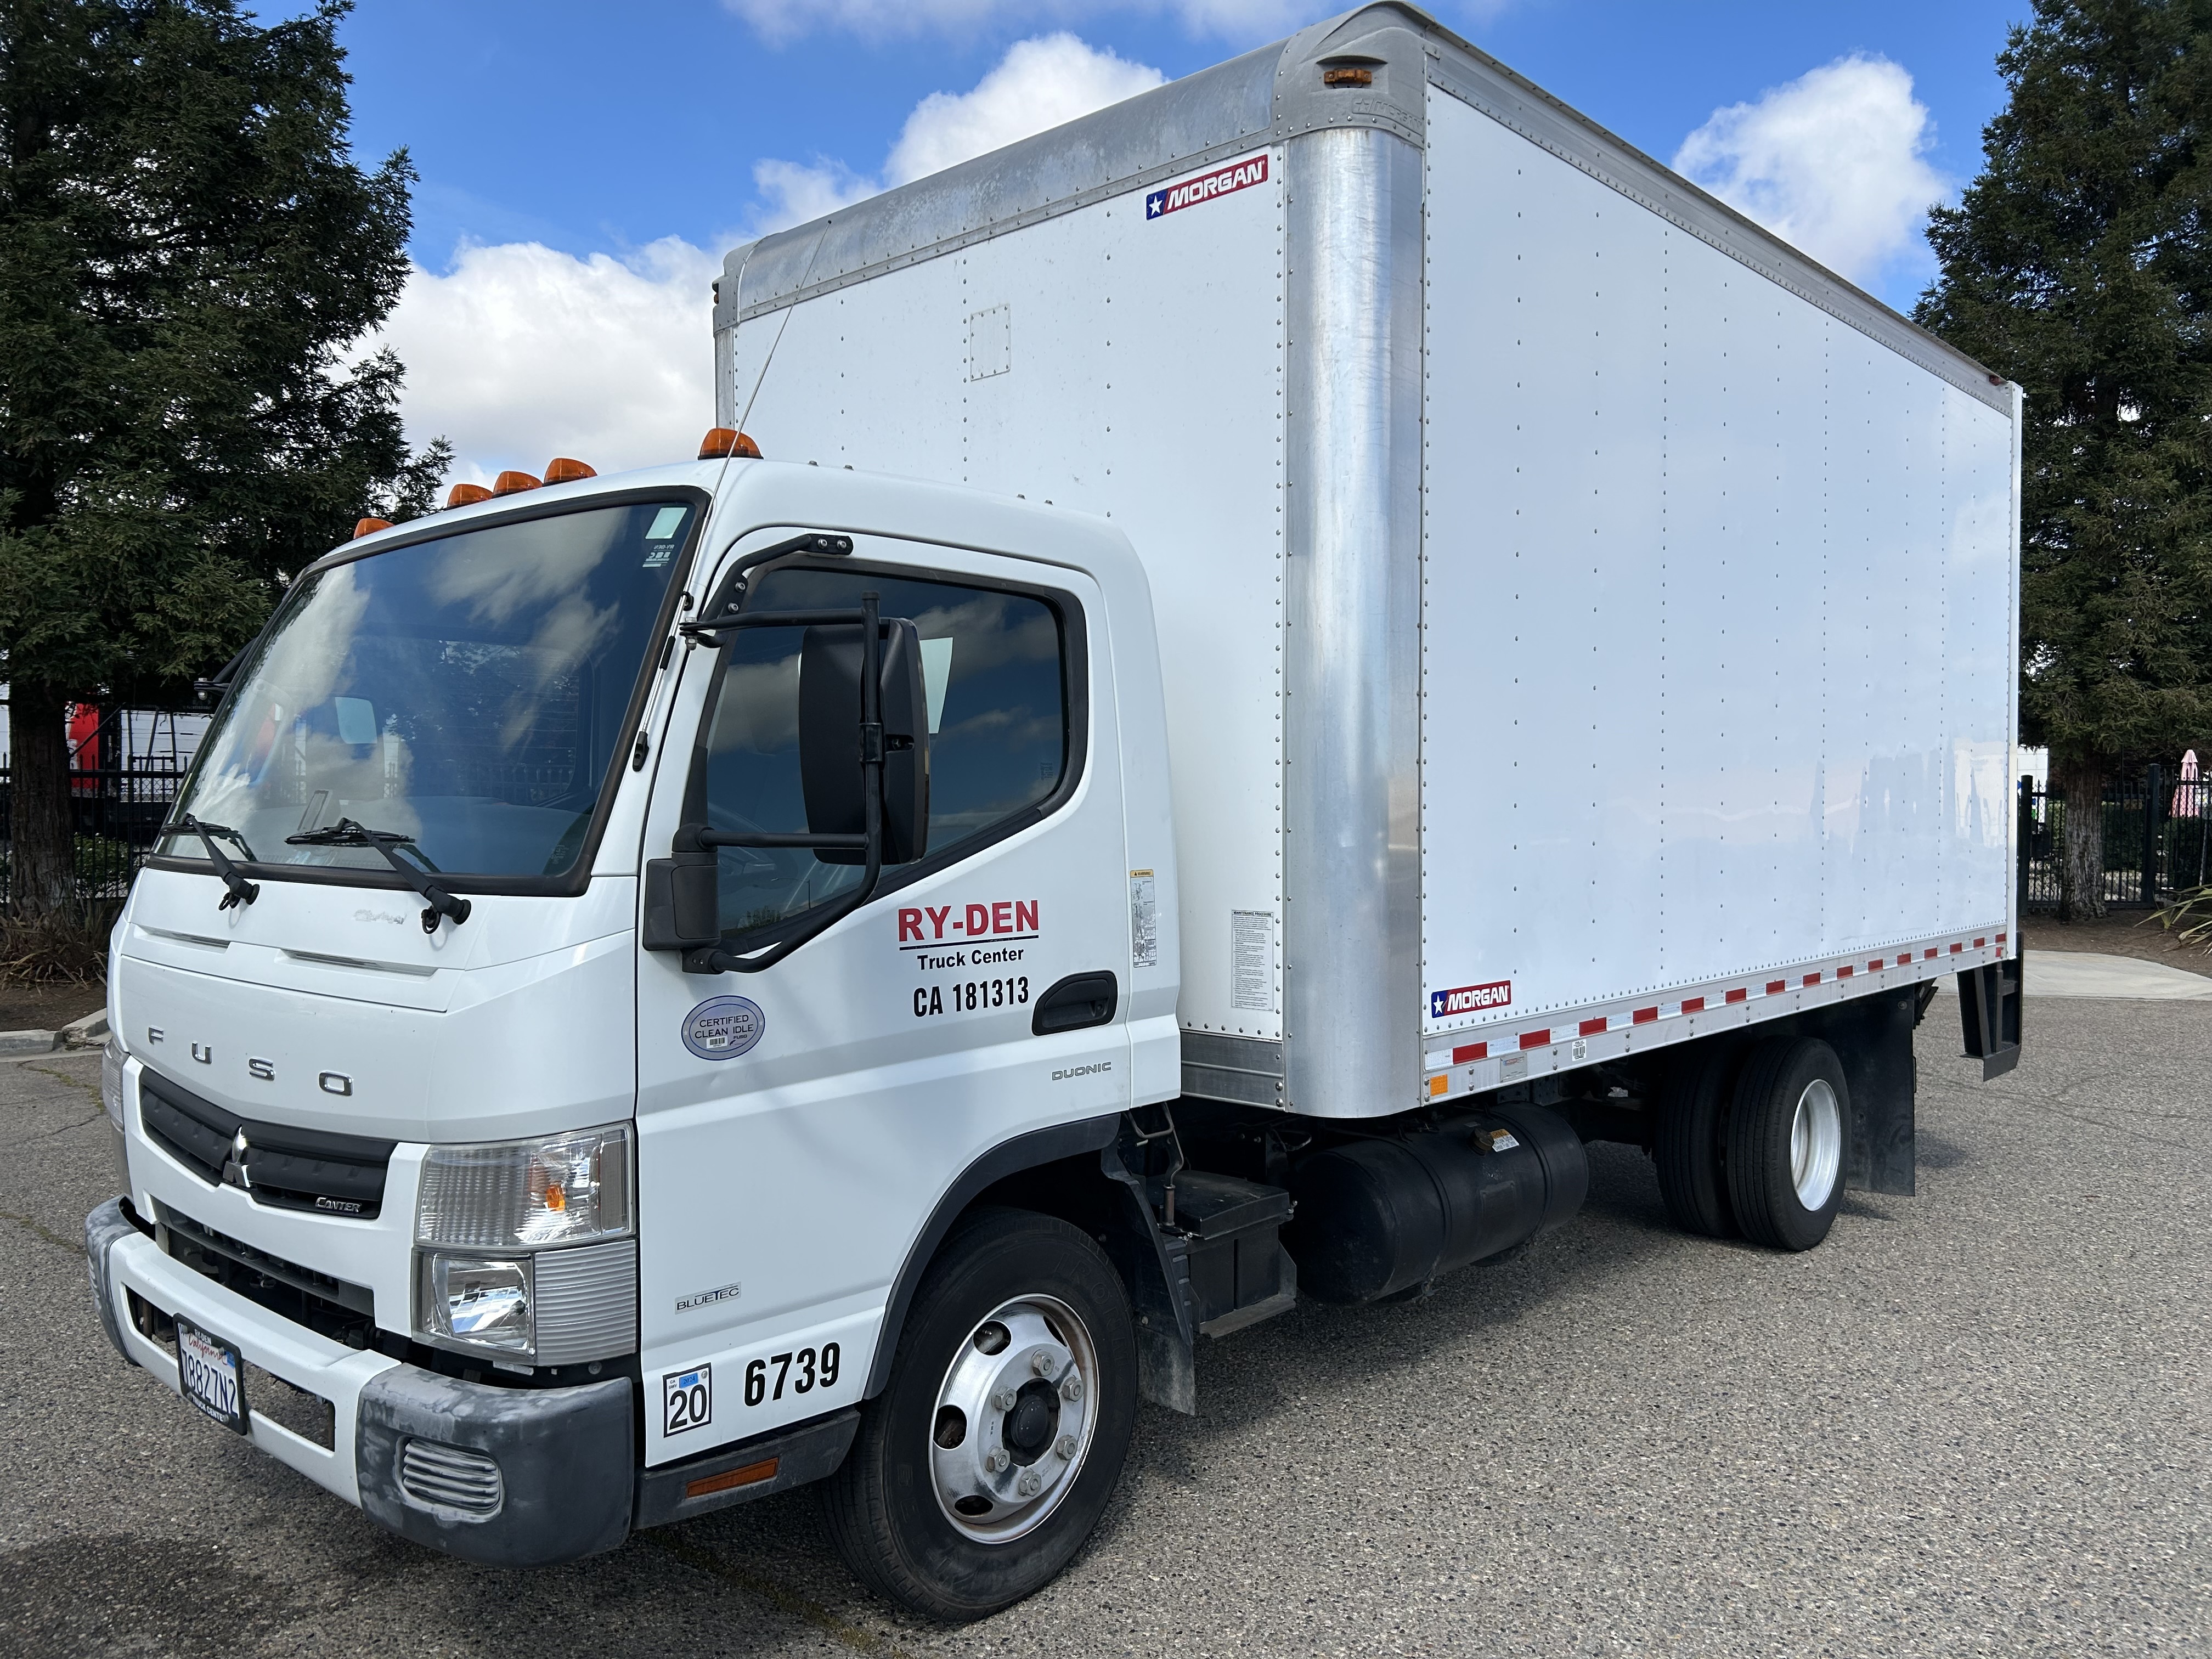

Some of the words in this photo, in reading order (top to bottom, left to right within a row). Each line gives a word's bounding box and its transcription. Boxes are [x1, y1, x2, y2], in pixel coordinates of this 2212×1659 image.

[1167, 160, 1262, 210] MORGAN
[898, 900, 1039, 942] RY-DEN
[917, 951, 966, 970] Truck
[971, 947, 1024, 965] Center
[913, 986, 944, 1017] CA
[952, 976, 1029, 1012] 181313
[1447, 985, 1508, 1012] MORGAN
[695, 1028, 729, 1039] CLEAN
[732, 1024, 754, 1034] IDLE
[699, 1014, 749, 1028] CERTIFIED
[149, 1025, 354, 1096] FUSO
[1052, 1062, 1111, 1081] DUONIC
[315, 1197, 362, 1212] CANTER
[676, 1285, 740, 1310] BLUETEC
[189, 1333, 228, 1366] California
[744, 1342, 840, 1407] 6739
[207, 1406, 224, 1423] CENTE
[669, 1384, 707, 1430] 20
